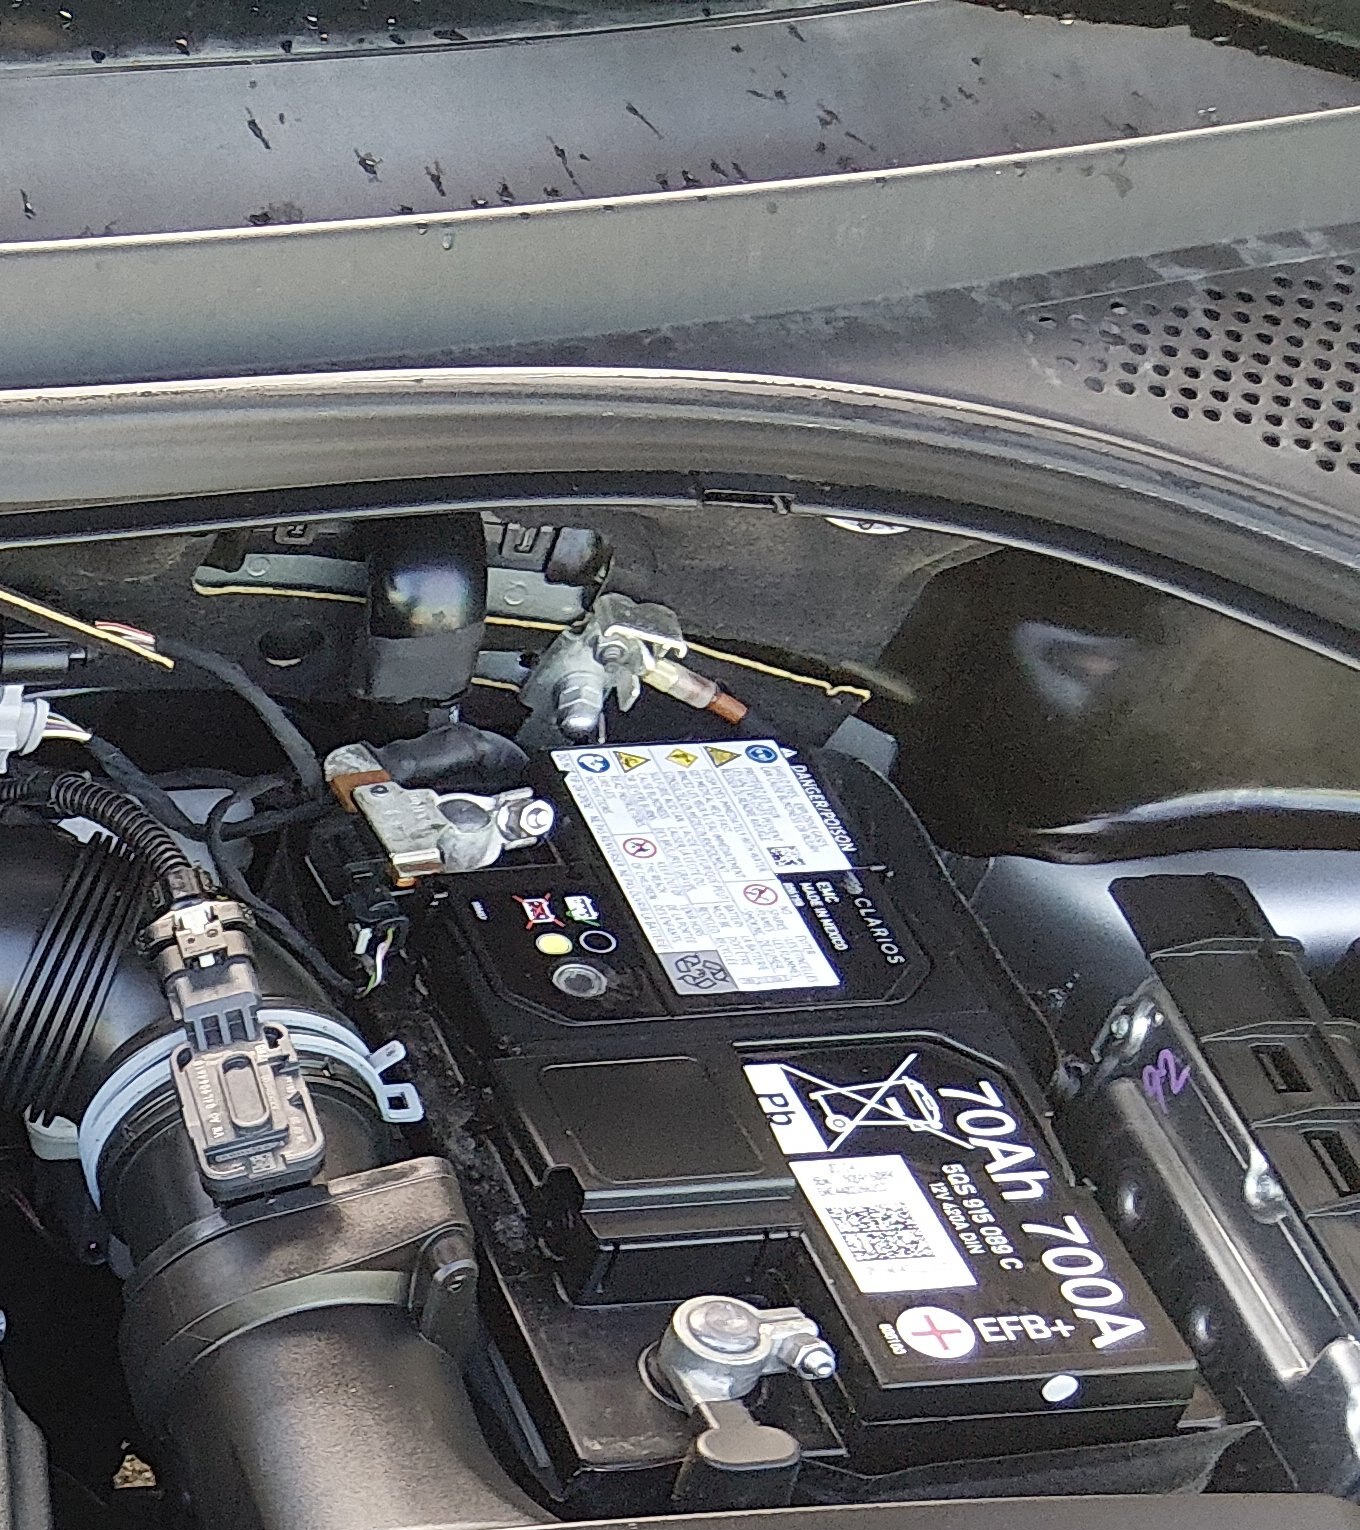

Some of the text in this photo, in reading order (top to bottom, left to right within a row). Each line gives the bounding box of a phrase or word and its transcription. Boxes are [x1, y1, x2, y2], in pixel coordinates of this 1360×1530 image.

[793, 764, 857, 852] DANGER/POISON
[800, 882, 849, 951] MADE IN MEXICO
[816, 881, 840, 903] EMC
[854, 898, 906, 963] CLARIOS
[758, 1093, 792, 1126] Pb
[929, 1182, 954, 1201] 12V
[958, 1232, 987, 1255] DIN
[937, 1080, 1146, 1350] 70Ah 700A
[942, 1164, 1024, 1270] 5QS 915 089 C
[973, 1316, 1076, 1346] EFB+
